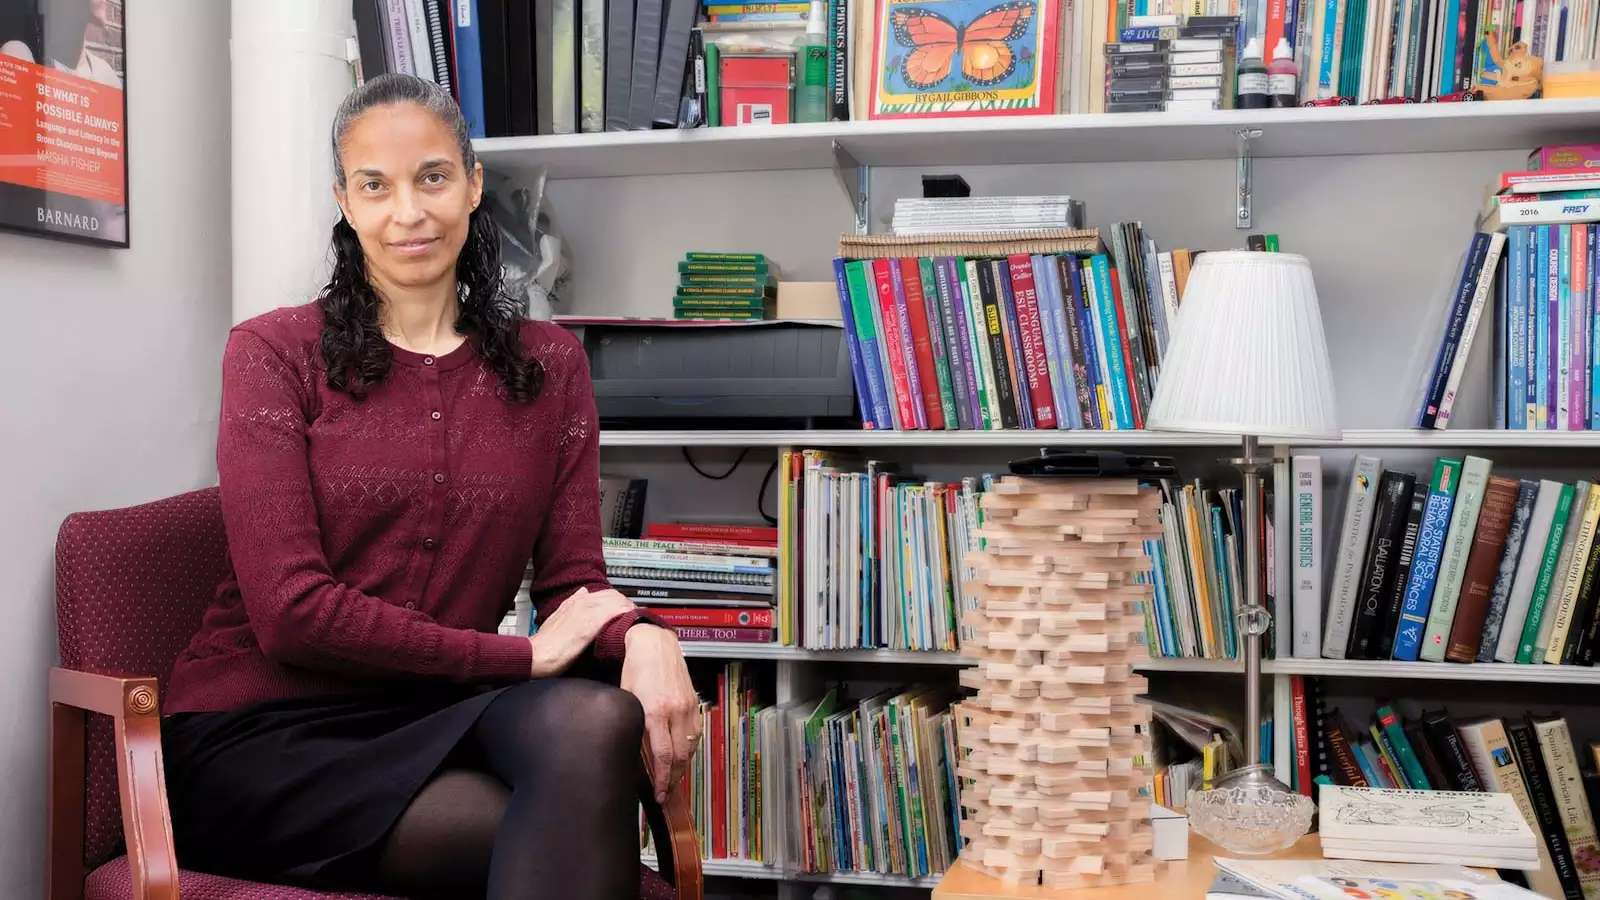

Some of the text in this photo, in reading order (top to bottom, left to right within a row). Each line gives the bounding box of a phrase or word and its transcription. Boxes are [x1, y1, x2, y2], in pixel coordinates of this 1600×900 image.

[834, 2, 846, 104] PHYSICS ACTIVITIES
[36, 101, 83, 124] POSSIBLE
[52, 87, 78, 105] WHAT
[80, 95, 90, 108] IS
[915, 91, 999, 103] BY GAIL GIBBONS
[36, 148, 102, 174] MAISHA FISHER
[38, 207, 99, 231] BARNARD
[1520, 204, 1590, 216] 2016 FREY
[1550, 249, 1558, 301] COURSE DESIGN
[1460, 281, 1472, 304] School
[1456, 304, 1466, 316] and
[1015, 290, 1039, 389] ESL CLASSROOMS
[1025, 288, 1047, 376] BILINGUAL AND
[1449, 317, 1463, 338] Society
[1300, 493, 1312, 526] GENERAL
[1350, 496, 1365, 547] STATISTICS
[1436, 496, 1451, 528] BASIC
[653, 542, 675, 550] PEACE
[1300, 528, 1312, 568] STATISTICS
[1399, 522, 1418, 566] EVALUATION
[1406, 495, 1439, 610] BEHAVIORAL SCIENCES
[1425, 530, 1444, 580] STATISTICS
[1568, 520, 1592, 584] ETHNOGRAPHY
[652, 590, 668, 598] GAME
[1337, 563, 1354, 627] PSYCHOLOGY
[1556, 585, 1575, 629] UNBOUND
[712, 628, 737, 640] TOO!
[1294, 695, 1304, 726] Through
[1298, 750, 1307, 766] Eyes
[1326, 728, 1359, 780] Masterful
[1544, 728, 1578, 825] Spanish American Life
[1550, 834, 1571, 879] FULL HOUSE
